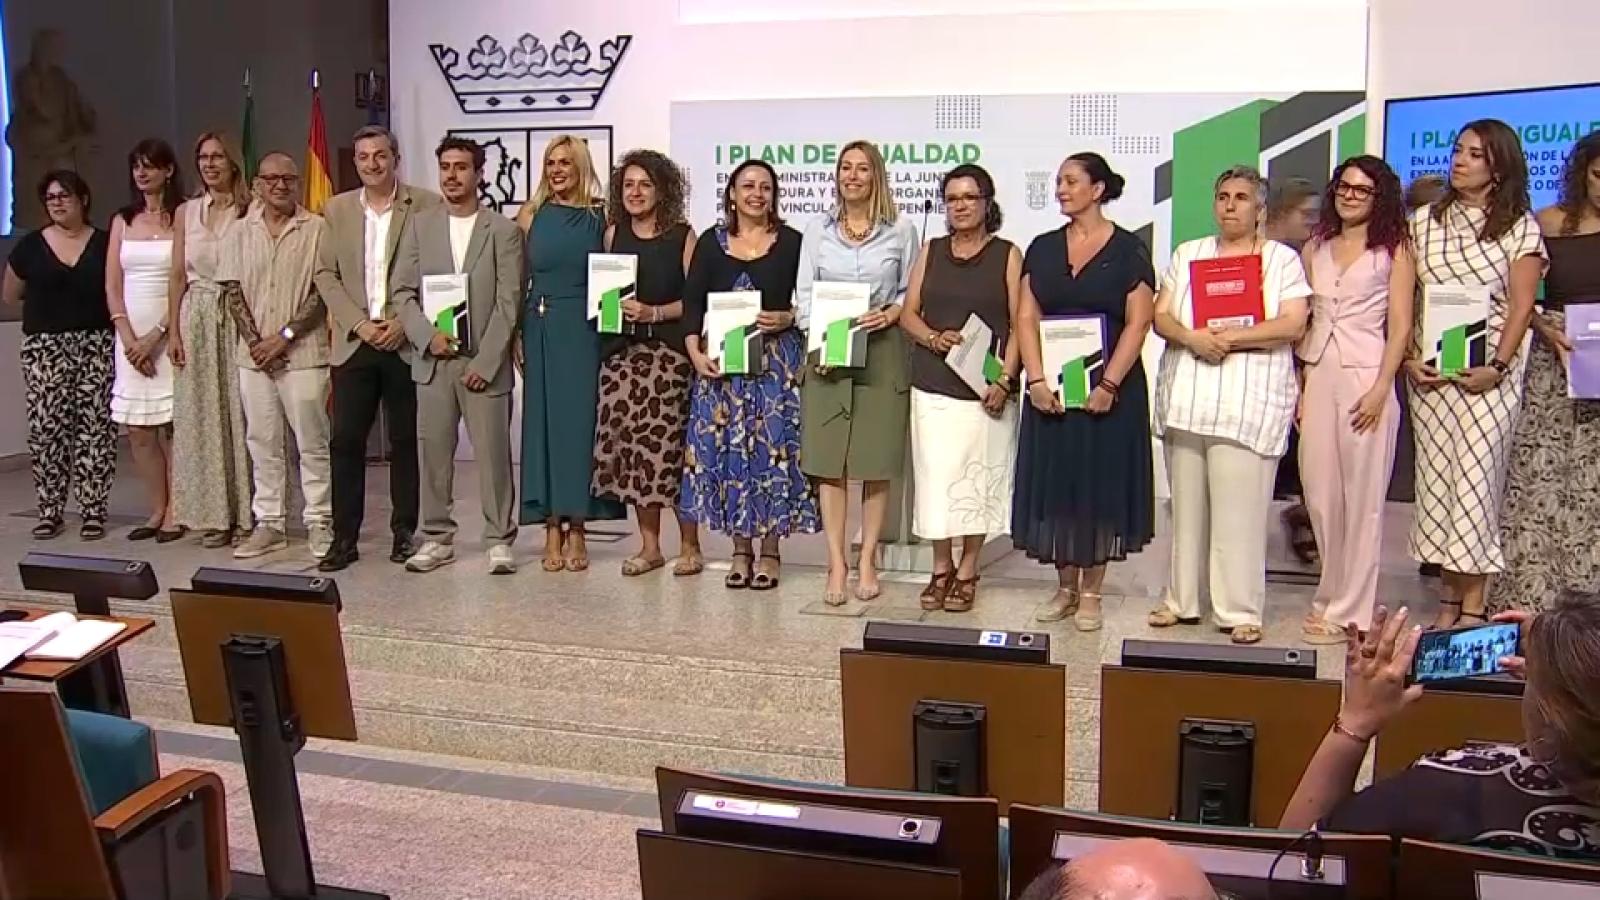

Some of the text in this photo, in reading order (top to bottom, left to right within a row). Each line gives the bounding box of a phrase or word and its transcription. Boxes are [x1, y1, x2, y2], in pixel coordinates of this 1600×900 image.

[1422, 129, 1456, 149] PLA
[716, 144, 722, 165] I
[803, 144, 837, 164] DE
[1541, 149, 1557, 160] DE
[896, 172, 912, 183] LA
[819, 187, 827, 198] Y
